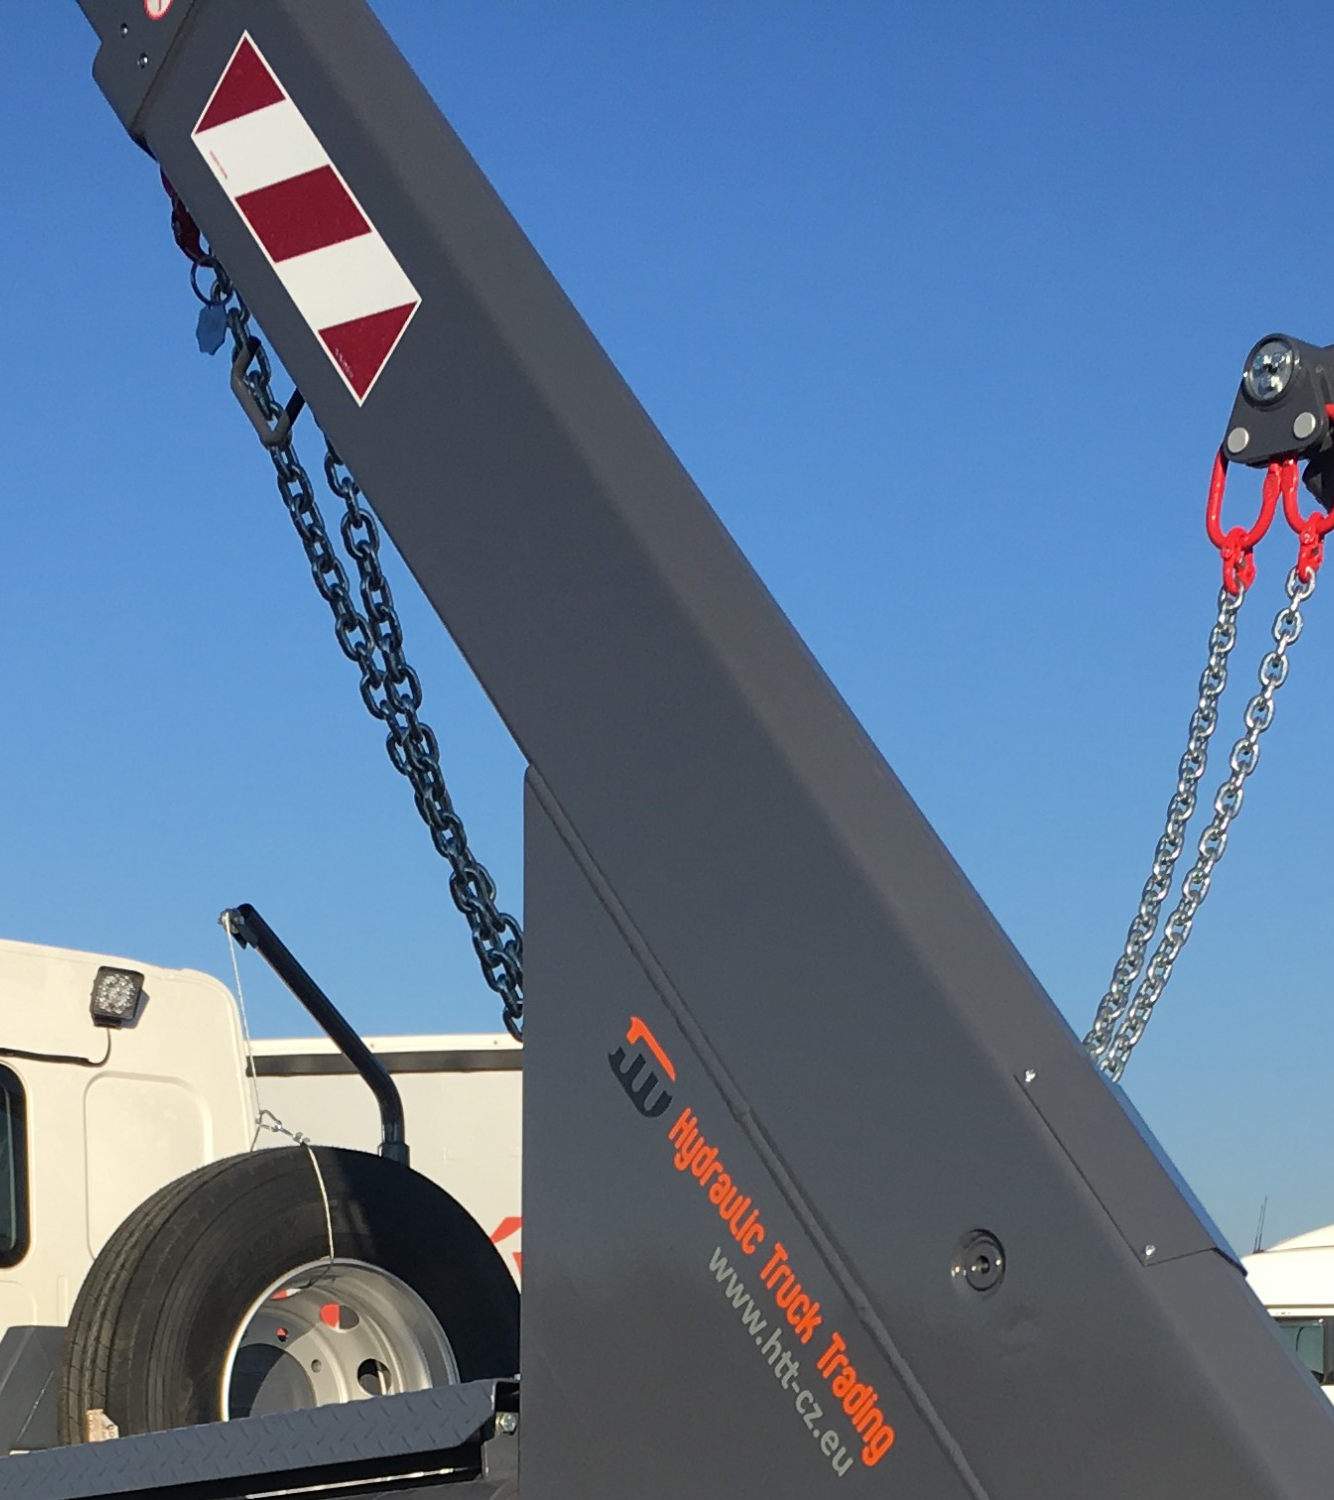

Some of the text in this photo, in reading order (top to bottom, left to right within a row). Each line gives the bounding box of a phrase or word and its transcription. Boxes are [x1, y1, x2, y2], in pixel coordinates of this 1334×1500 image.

[668, 1107, 895, 1466] Hydraulic Truck Trading
[709, 1247, 854, 1477] www.htt-cz.eu
